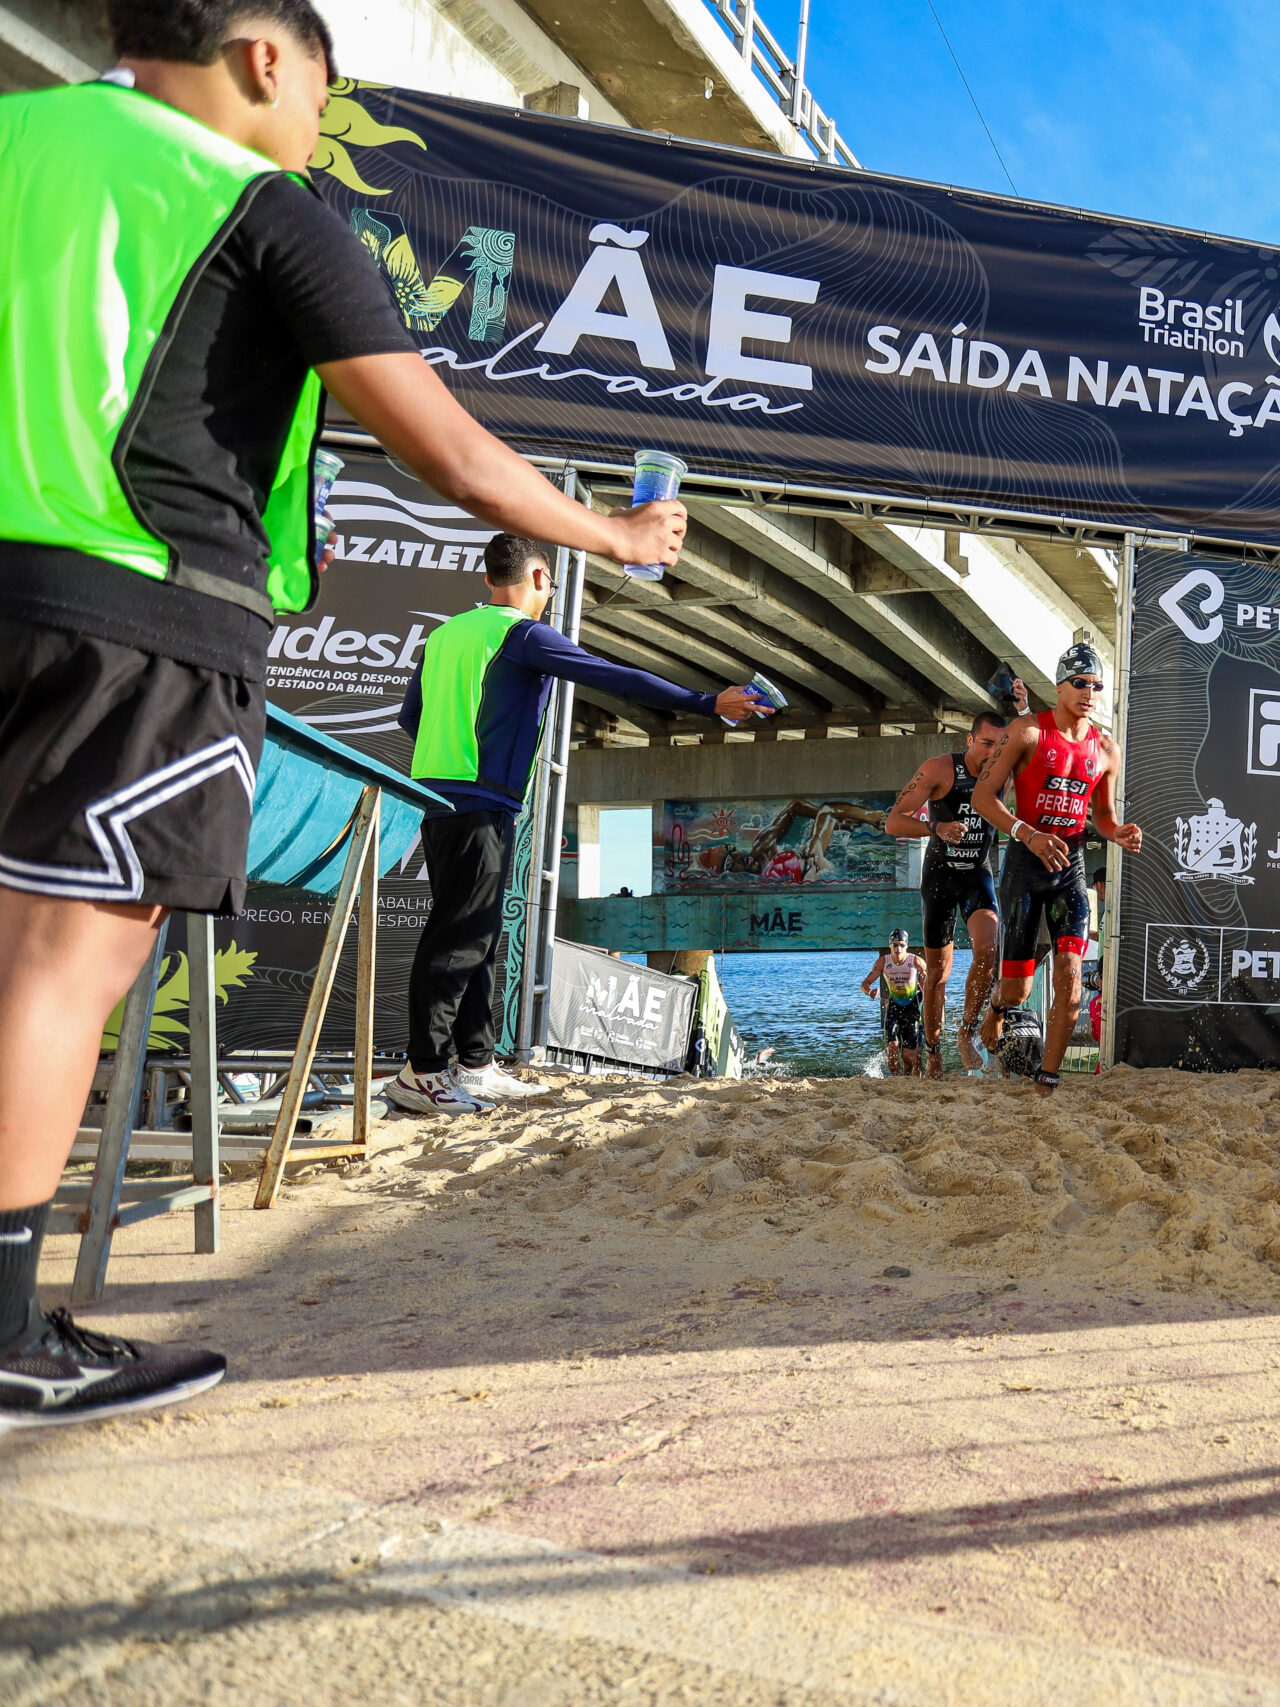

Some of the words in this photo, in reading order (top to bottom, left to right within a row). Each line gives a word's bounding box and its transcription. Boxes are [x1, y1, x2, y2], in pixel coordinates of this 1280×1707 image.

[1139, 286, 1245, 336] Brasil
[1138, 322, 1244, 358] Triathlon
[419, 322, 803, 415] alvada
[864, 322, 1053, 399] SAÍDA
[333, 671, 358, 681] DOS
[277, 678, 325, 691] ESTADO
[326, 681, 344, 692] DA
[346, 684, 384, 696] BAHIA
[1047, 777, 1087, 795] SESI
[1035, 793, 1084, 815] PEREIRA
[963, 816, 982, 829] BRA
[1040, 815, 1077, 827] FIESP
[301, 911, 358, 926] RENA
[458, 1073, 484, 1086] CORRE
